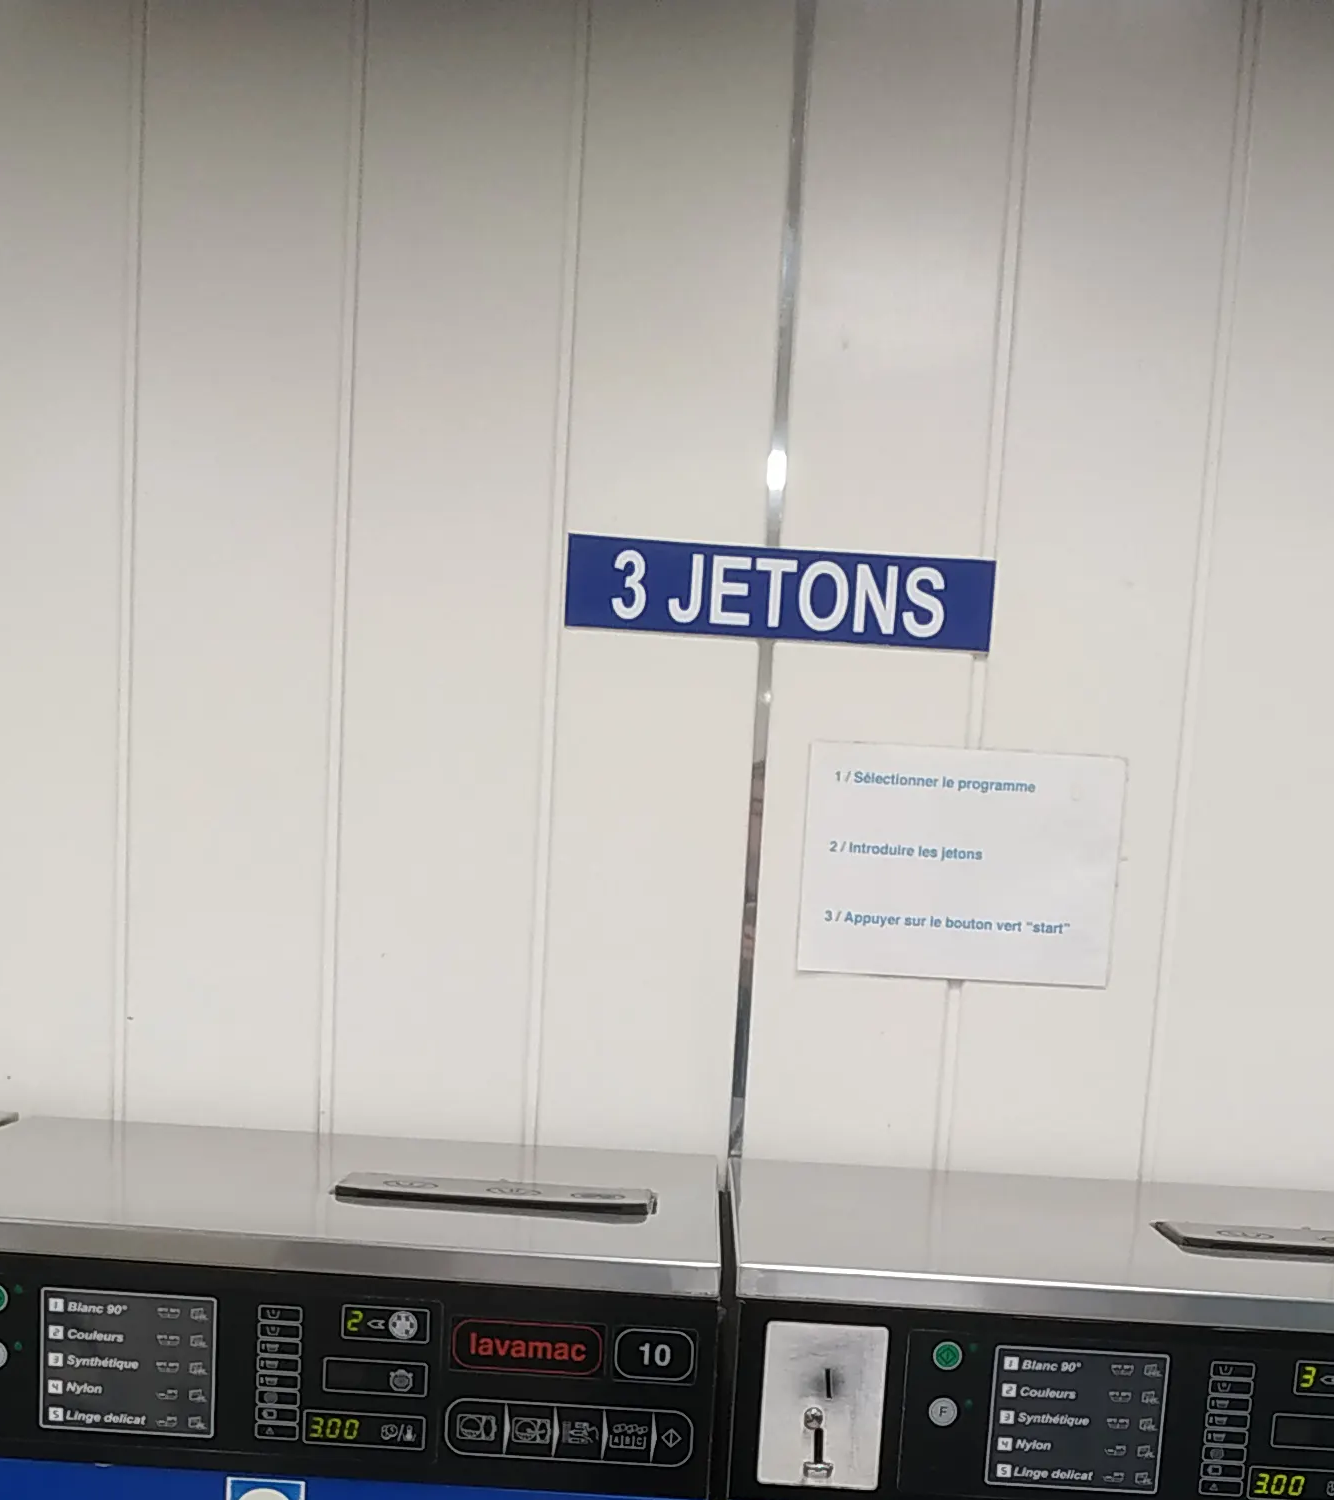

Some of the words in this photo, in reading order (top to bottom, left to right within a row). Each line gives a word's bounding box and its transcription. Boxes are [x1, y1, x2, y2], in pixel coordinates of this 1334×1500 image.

[610, 549, 648, 621] 3
[667, 553, 946, 639] JETONS
[835, 771, 841, 782] 1
[853, 771, 939, 788] Sélectionner
[942, 776, 955, 789] le
[957, 779, 1036, 794] programme
[829, 841, 838, 852] 2
[848, 841, 915, 857] Introduire
[918, 846, 938, 858] les
[940, 846, 983, 862] jetons
[824, 910, 833, 922] 3
[844, 911, 901, 927] Appuyer
[904, 917, 926, 927] sur
[929, 916, 942, 928] le
[945, 916, 993, 931] bouton
[996, 921, 1022, 933] vert
[67, 1301, 104, 1315] Blanc
[347, 1310, 363, 1332] 2
[67, 1328, 124, 1343] Couleurs
[470, 1332, 587, 1362] lavamac
[639, 1343, 671, 1366] 10
[66, 1355, 139, 1371] Synthétique
[1021, 1360, 1058, 1373] Blanc
[1300, 1366, 1317, 1388] 3
[66, 1381, 103, 1395] Nylon
[1020, 1387, 1076, 1400] Couleurs
[66, 1409, 101, 1425] Linge
[938, 1406, 948, 1417] F
[1017, 1413, 1090, 1428] Synthétique
[1015, 1439, 1051, 1452] Nylon
[1013, 1467, 1049, 1481] Linge
